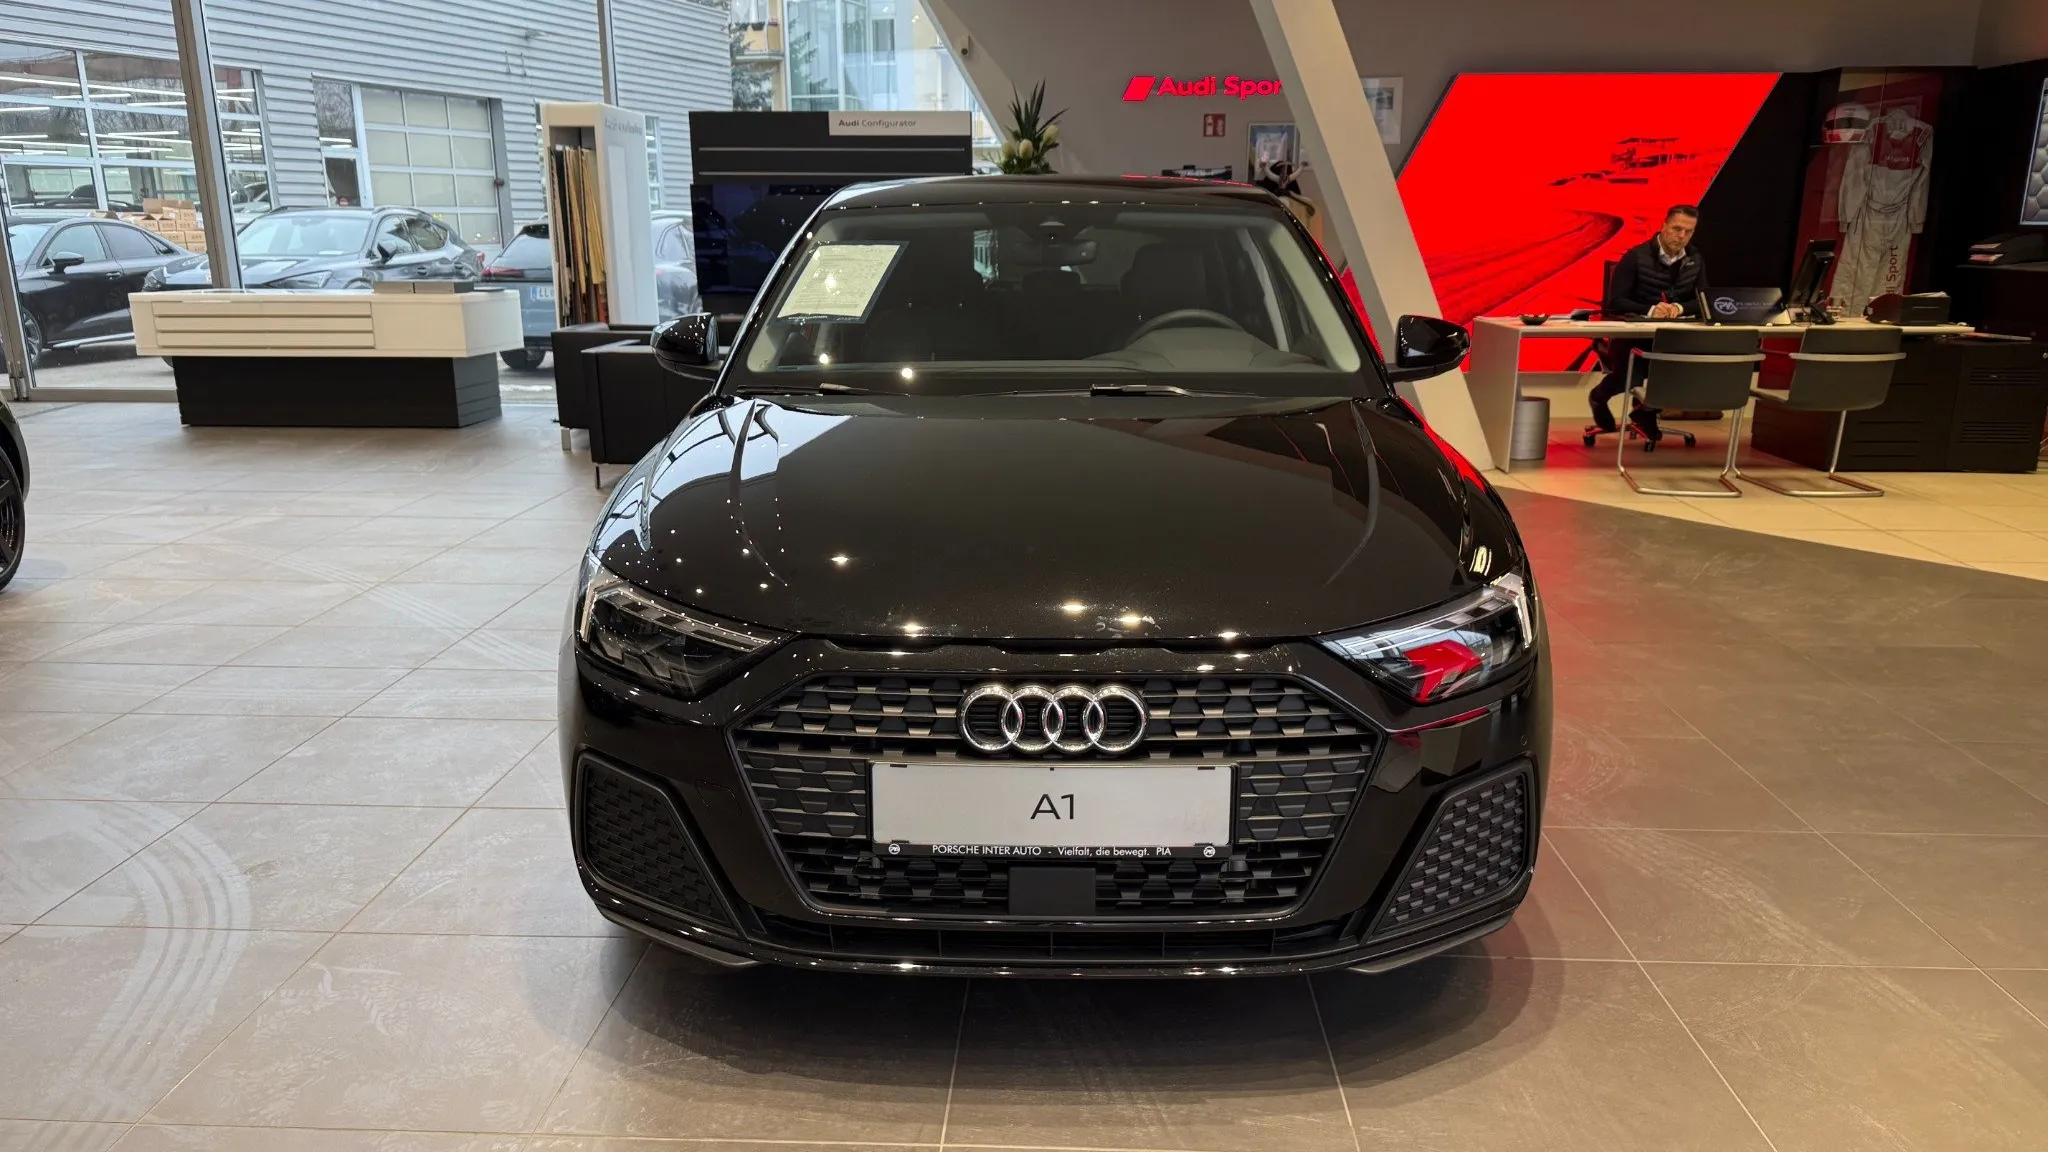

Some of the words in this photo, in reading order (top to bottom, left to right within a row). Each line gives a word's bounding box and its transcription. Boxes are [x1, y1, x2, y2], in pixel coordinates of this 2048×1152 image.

[1157, 76, 1217, 96] Audi
[1224, 75, 1282, 101] Spor
[838, 119, 860, 127] Audi
[861, 119, 917, 129] Configurator
[1885, 245, 1899, 282] Sport
[1030, 793, 1075, 820] A1
[932, 844, 980, 855] PORSCHE
[982, 845, 1010, 856] INTER
[1012, 846, 1042, 856] AUTO
[1058, 846, 1093, 857] Vielfalt,
[1096, 847, 1110, 856] die
[1113, 847, 1150, 858] bewegt.
[1156, 847, 1172, 856] PIA
